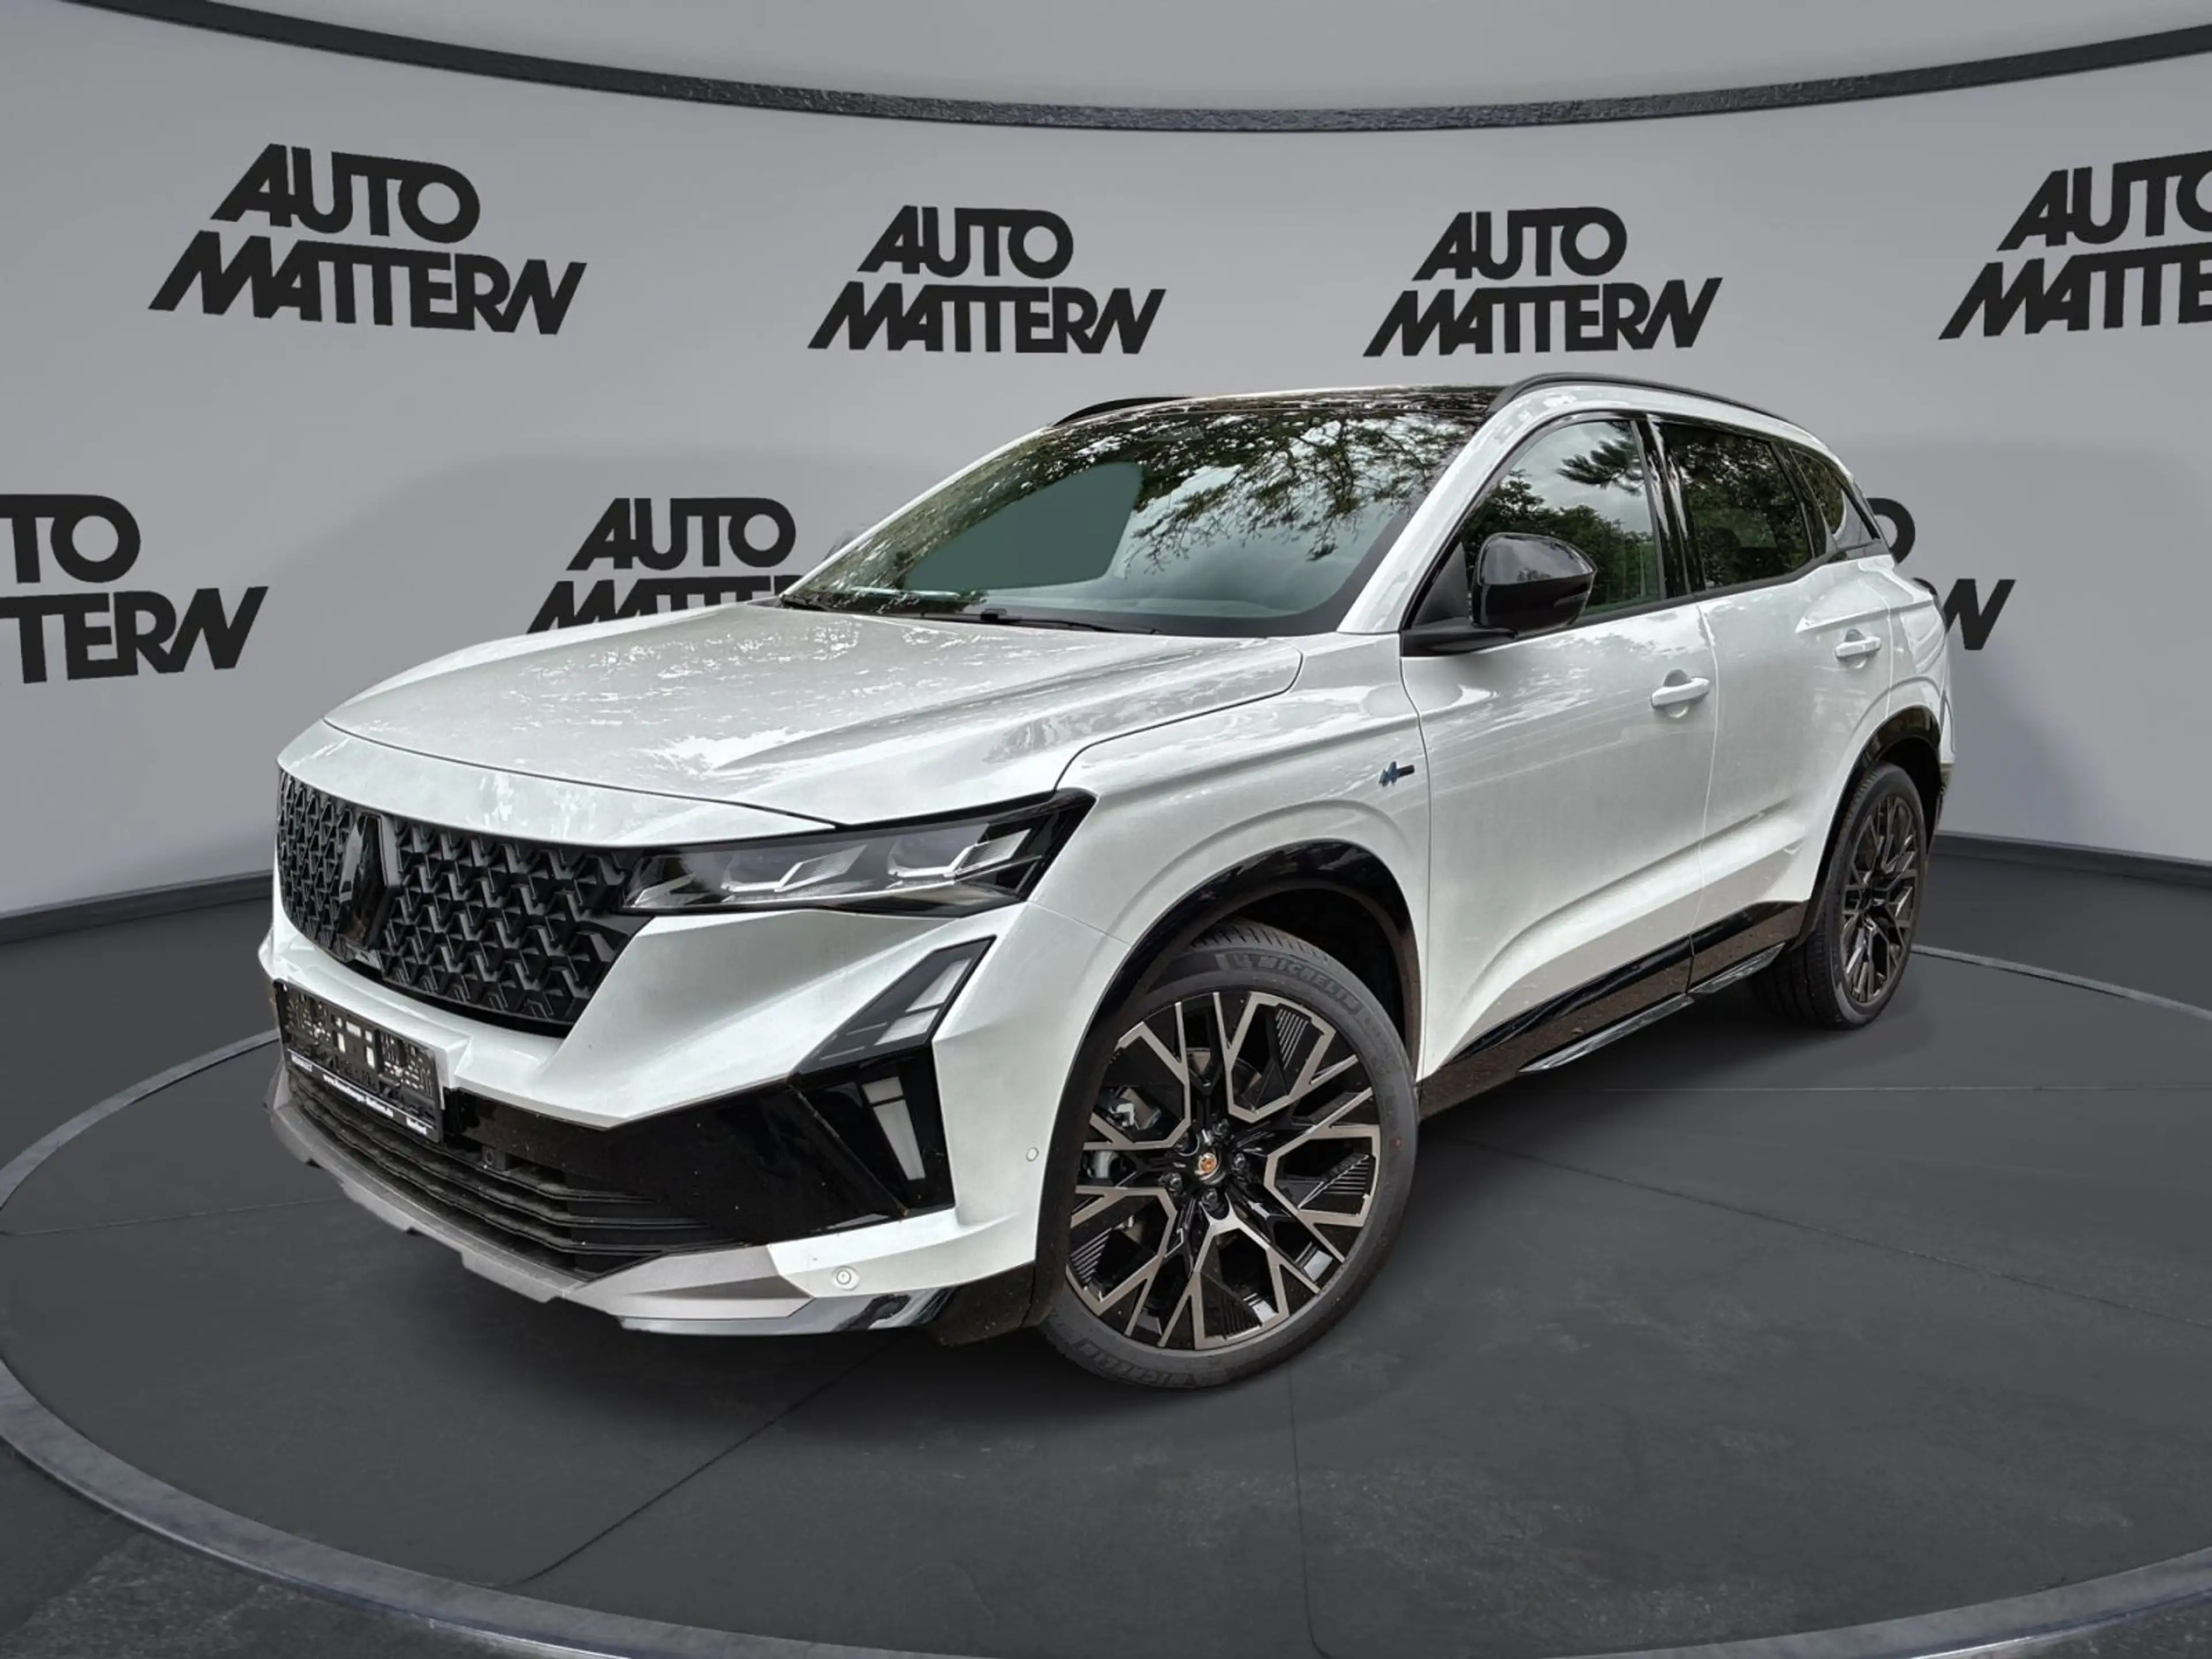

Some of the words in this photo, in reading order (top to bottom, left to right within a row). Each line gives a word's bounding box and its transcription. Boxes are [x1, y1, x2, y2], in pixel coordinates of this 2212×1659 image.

[210, 143, 480, 244] AUTO
[149, 230, 586, 335] MATTERN
[857, 206, 1073, 279] AUTO
[1412, 207, 1627, 281] AUTO
[808, 281, 1166, 354] MATTERN
[1363, 278, 1722, 357] MATTERN
[1938, 242, 2212, 340] MATTE
[0, 494, 141, 583] TO
[566, 498, 796, 570] AUTO
[0, 586, 268, 684] TERN
